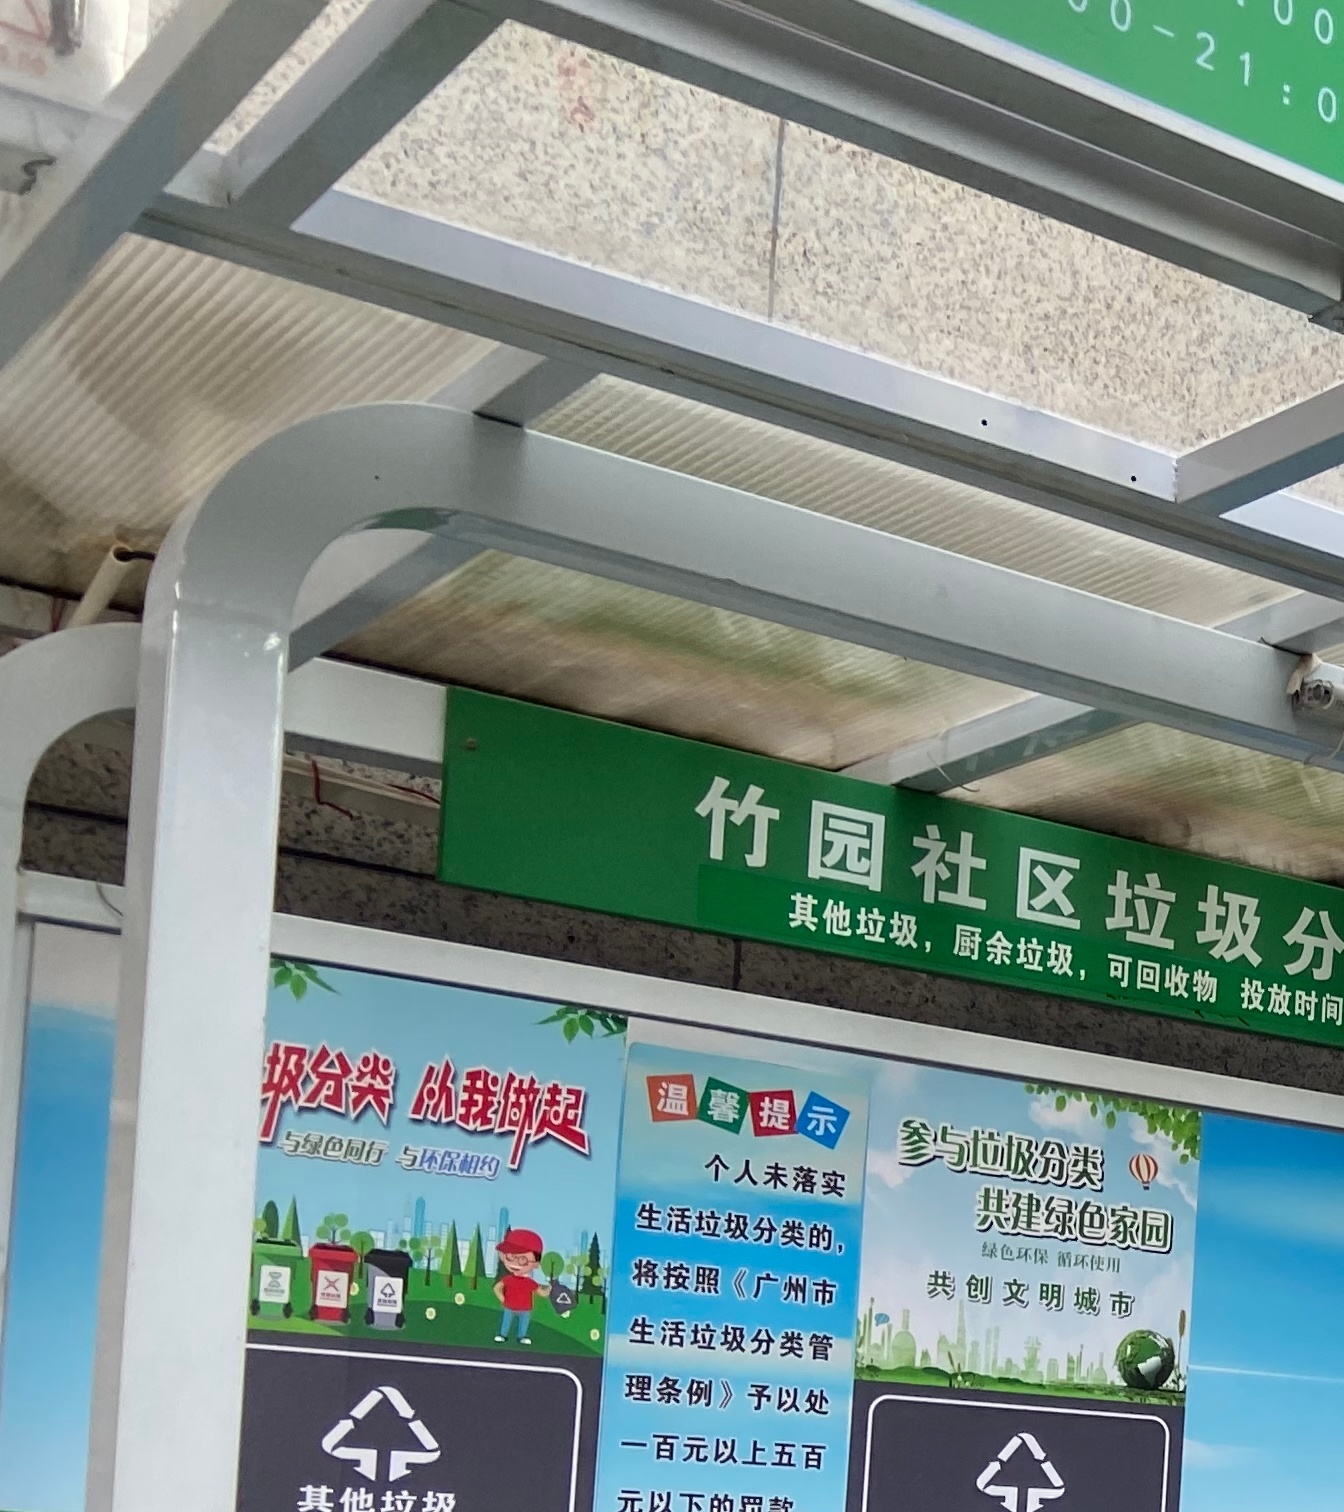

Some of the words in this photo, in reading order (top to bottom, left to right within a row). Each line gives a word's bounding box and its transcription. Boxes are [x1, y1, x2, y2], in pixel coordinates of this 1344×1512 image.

[408, 1052, 591, 1172] 从我做起
[654, 1080, 838, 1138] 温馨提示
[279, 1130, 389, 1166] 与绿色同行
[395, 1144, 501, 1180] 与环保相约
[704, 1154, 847, 1198] 个人未落实
[898, 1118, 1104, 1191] 参与垃圾分类
[636, 1203, 844, 1254] 生活垃圾分类的，
[976, 1187, 1173, 1254] 共建绿色家园
[981, 1241, 1049, 1264] 绿色环保
[1056, 1250, 1121, 1274] 循环使用
[631, 1258, 837, 1307] 将按照《广州市
[926, 1270, 1136, 1317] 共创文明城市
[628, 1317, 834, 1361] 生活垃圾分类管
[624, 1373, 830, 1416] 理条例》予以处
[620, 1433, 826, 1470] 一百元以上五百
